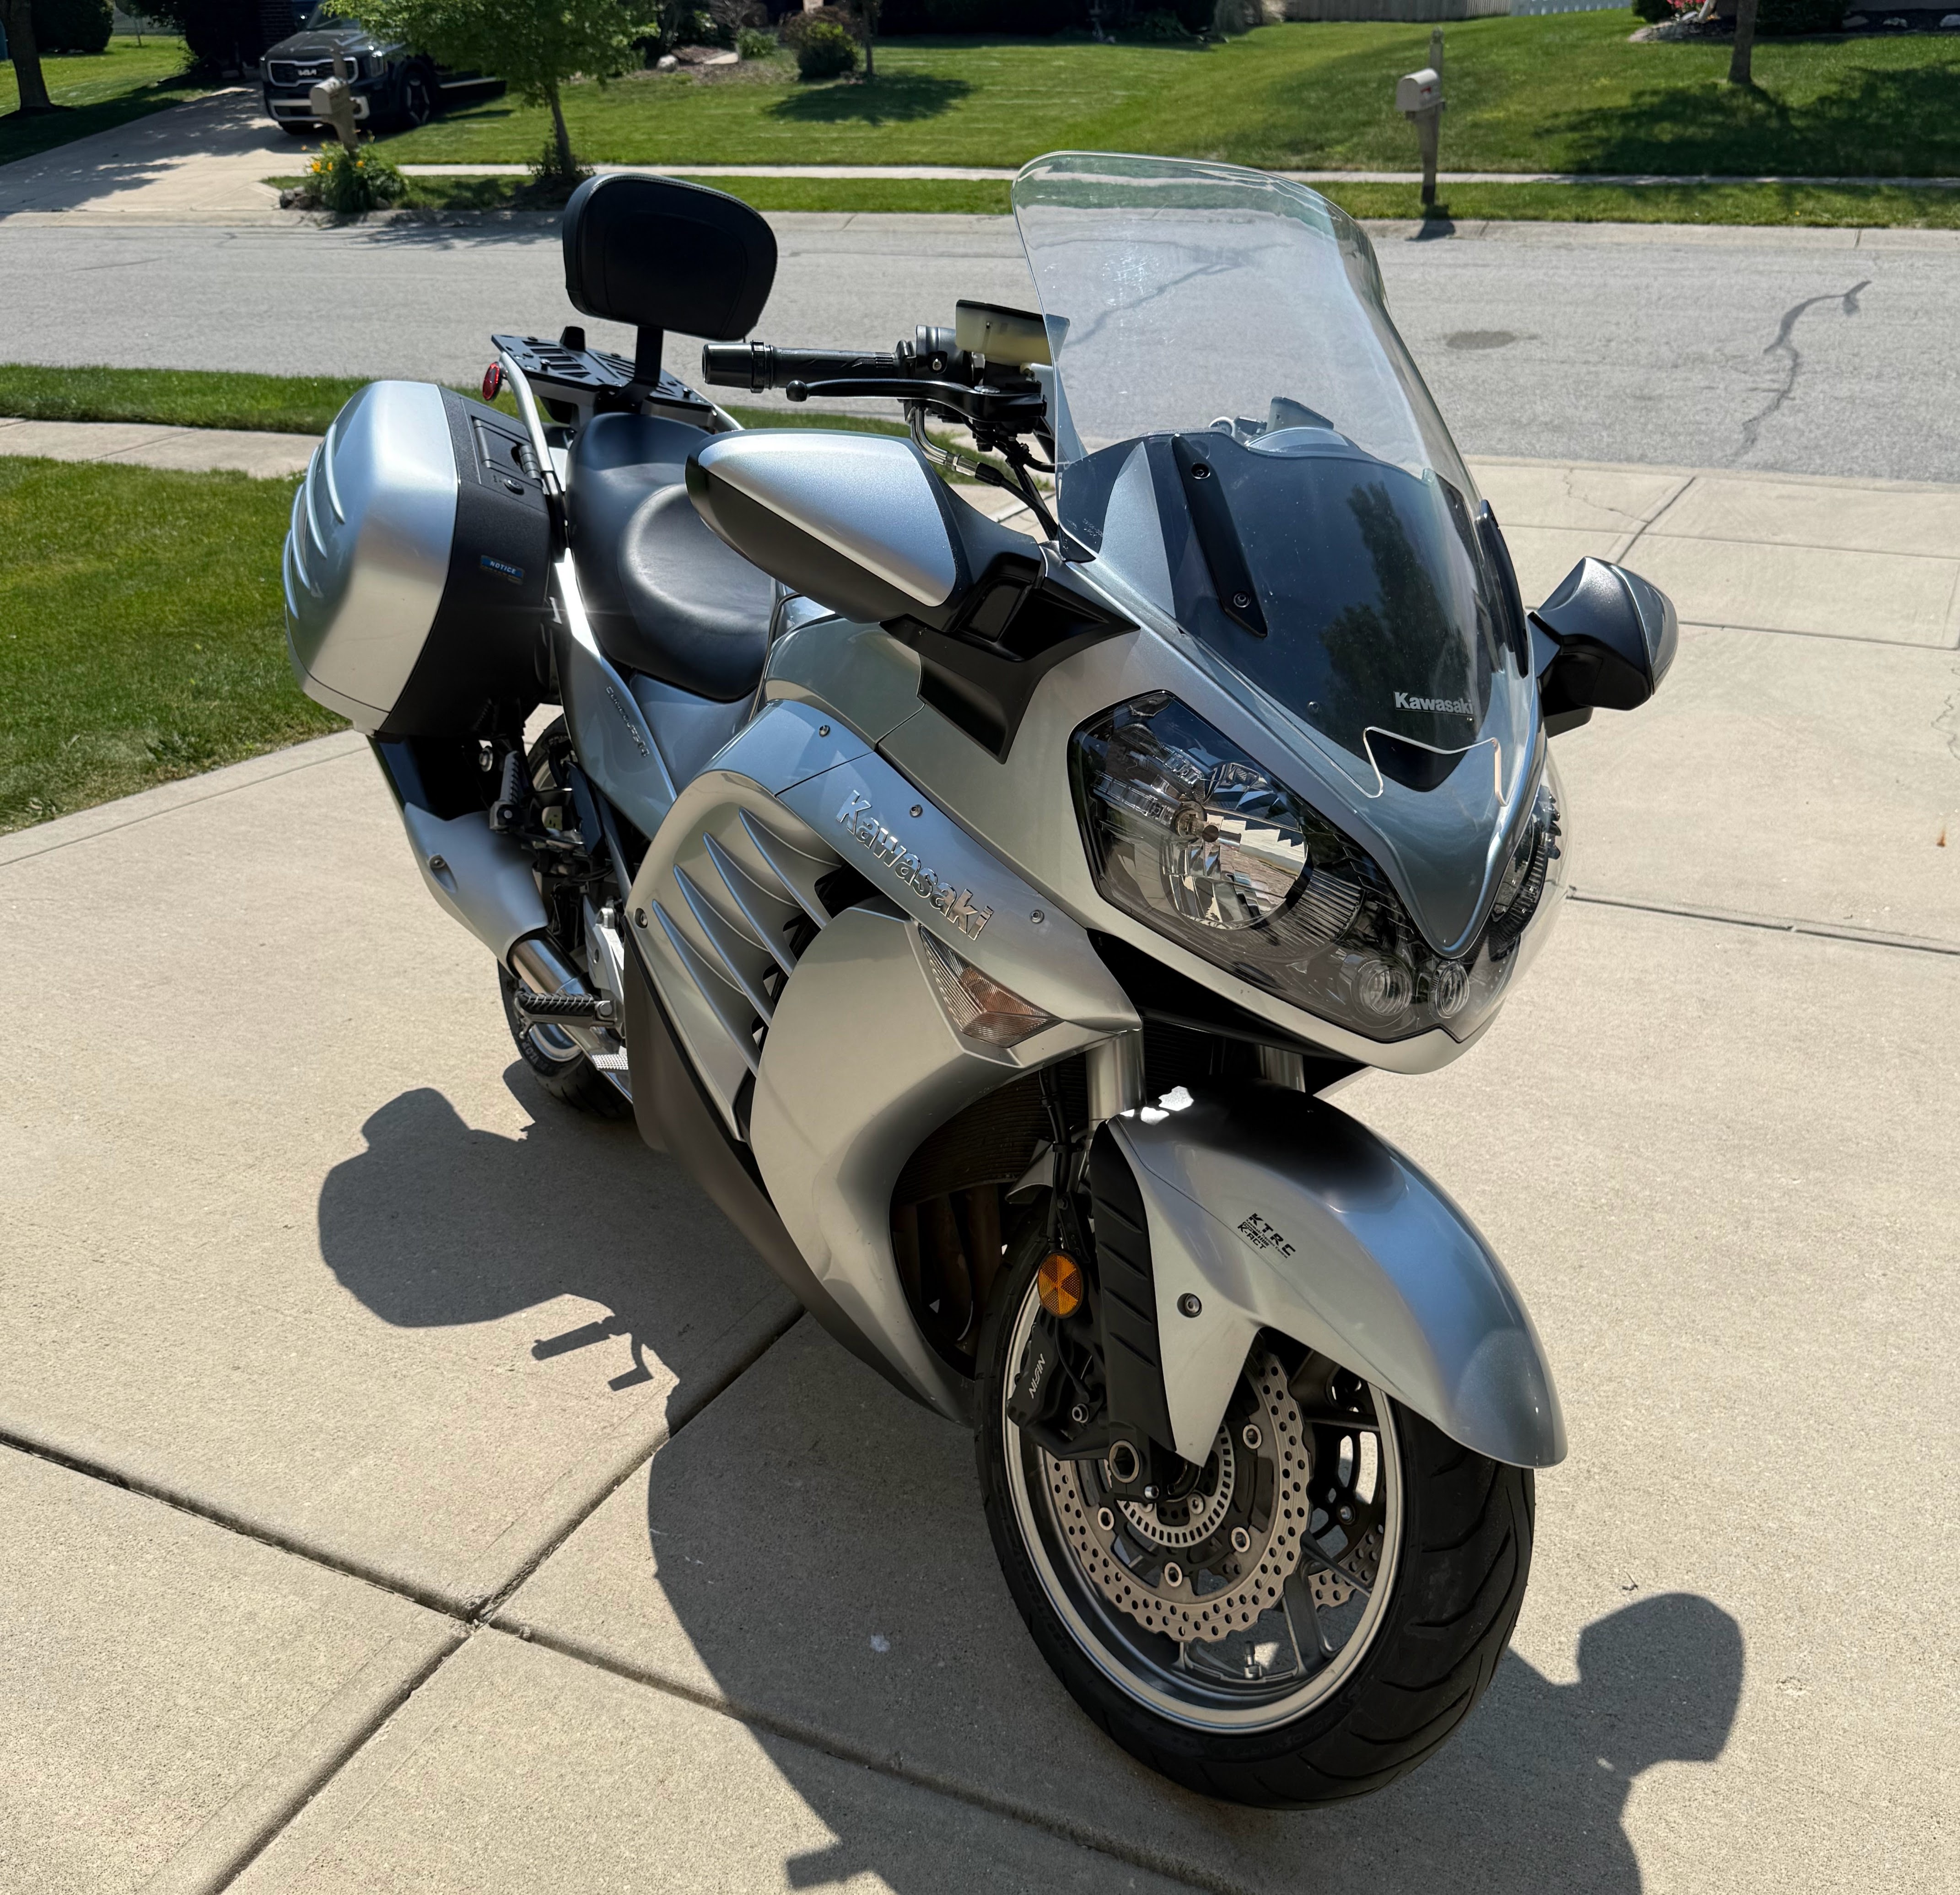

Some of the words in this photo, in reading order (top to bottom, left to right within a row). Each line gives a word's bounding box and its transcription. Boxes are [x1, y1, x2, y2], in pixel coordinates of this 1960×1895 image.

[490, 561, 517, 574] NOTICE
[1395, 692, 1474, 714] Kawasaki
[836, 790, 994, 941] Kawasaki
[1238, 1223, 1266, 1249] K-ACT
[1248, 1213, 1296, 1256] KTRC
